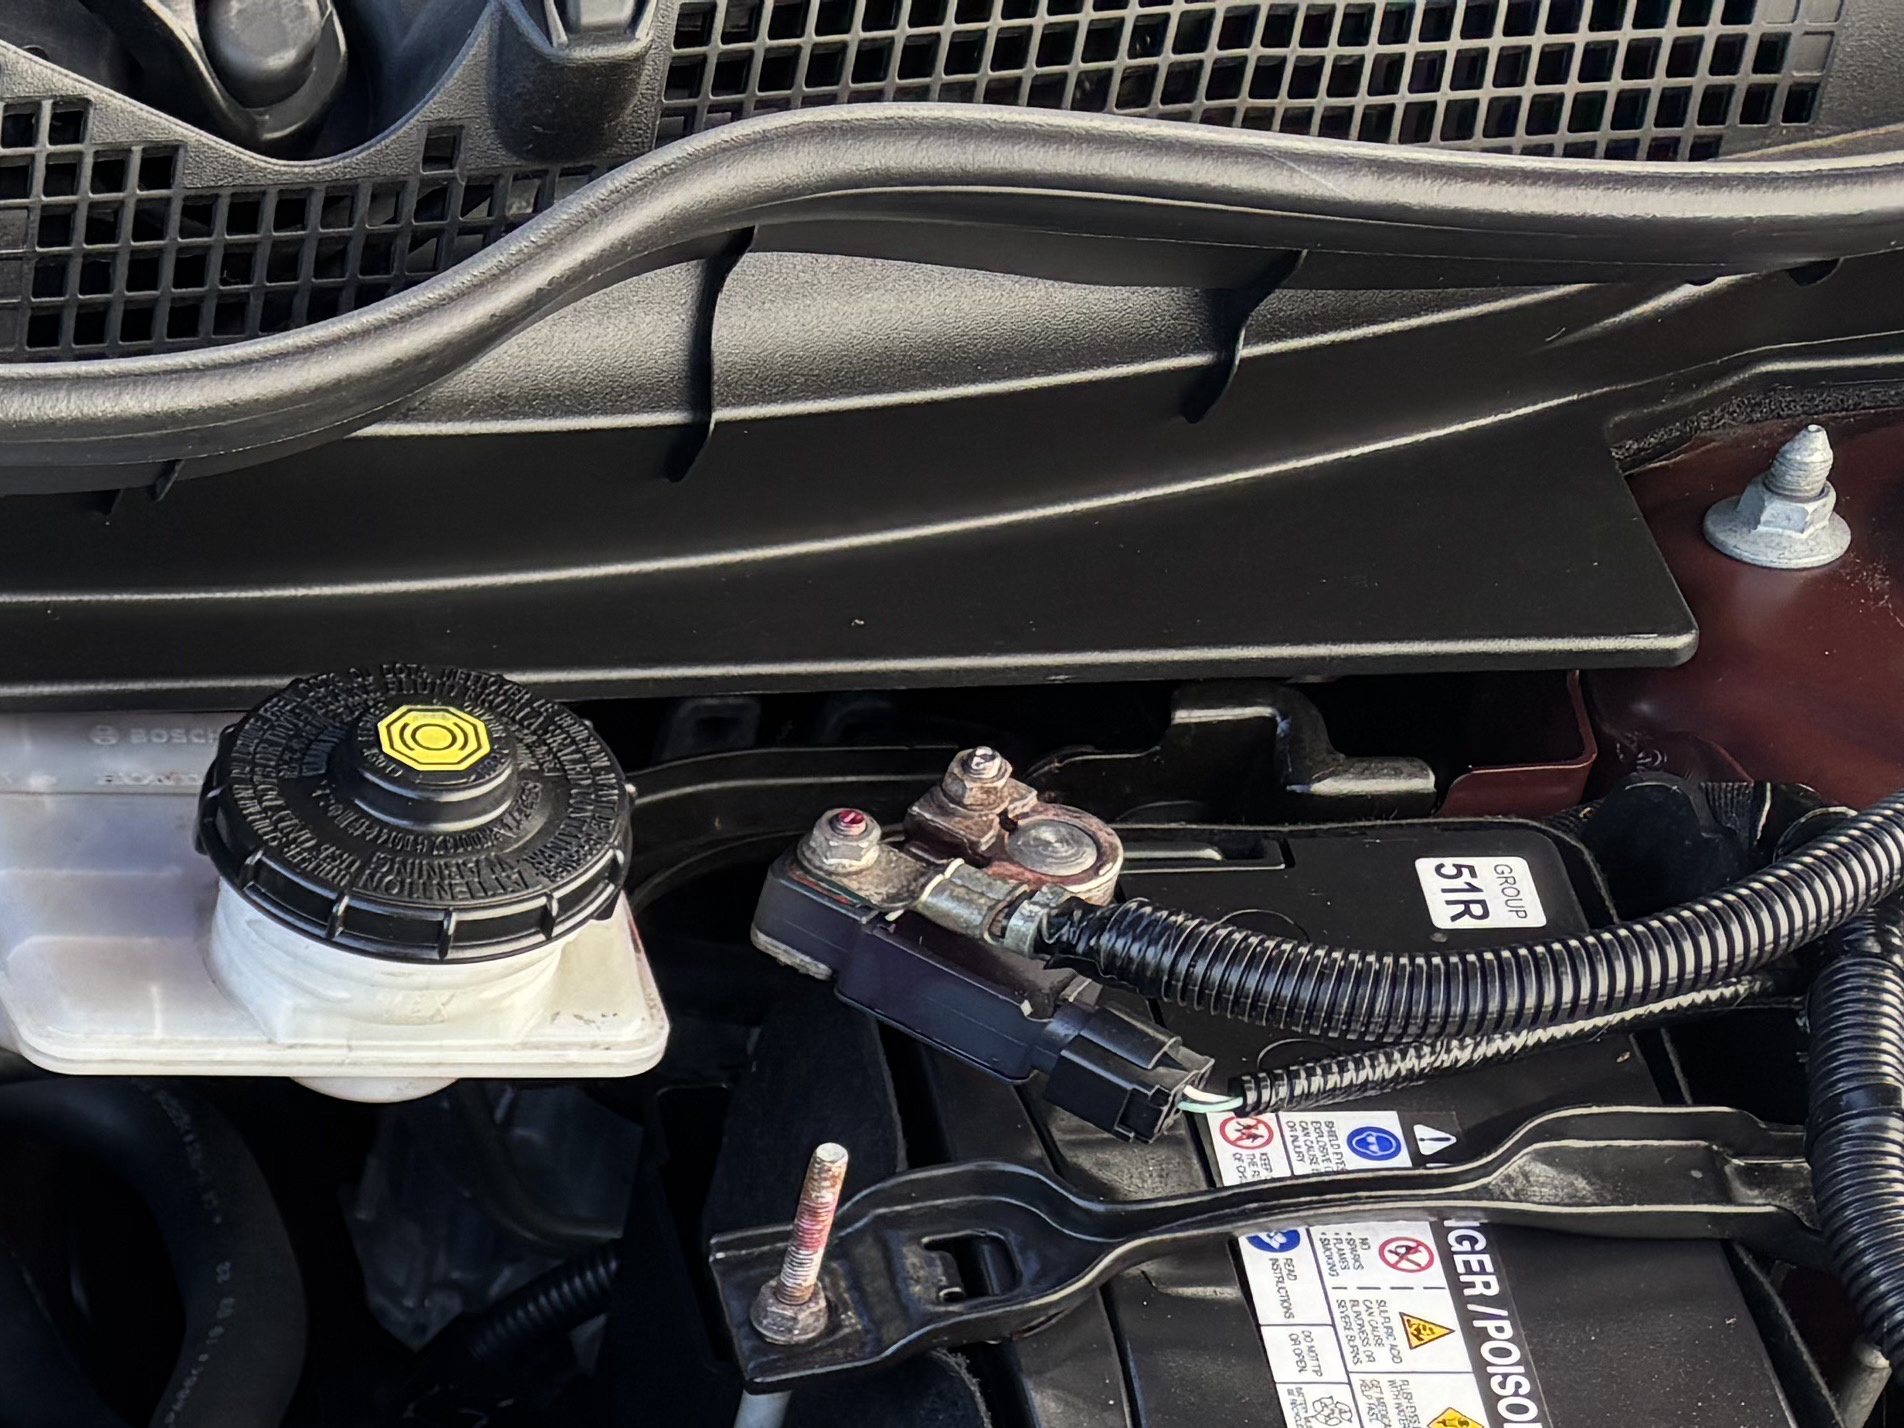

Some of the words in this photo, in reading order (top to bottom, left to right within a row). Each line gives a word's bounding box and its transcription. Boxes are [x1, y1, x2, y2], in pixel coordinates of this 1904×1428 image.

[253, 742, 282, 765] OR
[266, 809, 320, 849] ONLY
[308, 842, 363, 872] USE
[364, 850, 515, 880] WARNING
[353, 867, 535, 899] ATTENTION
[1434, 862, 1490, 922] 51R
[1494, 864, 1527, 919] GROUP
[1299, 1121, 1310, 1137] CAN
[1324, 1120, 1341, 1149] SHIELD
[1304, 1140, 1319, 1165] CAUSE
[1320, 1238, 1339, 1277] SMOKING
[1332, 1238, 1350, 1270] FLAMES
[1345, 1238, 1364, 1270] SPARKS
[1359, 1238, 1371, 1250] NO
[1284, 1258, 1297, 1281] READ
[1268, 1258, 1294, 1320] INSTRUCTIONS
[1336, 1300, 1354, 1331] SEVERE
[1363, 1300, 1375, 1317] CAN
[1369, 1320, 1385, 1347] CAUSE
[1289, 1334, 1301, 1346] OR
[1302, 1330, 1312, 1342] DO
[1349, 1300, 1372, 1347] BLINDNESS
[1363, 1350, 1376, 1362] OR
[1375, 1299, 1396, 1340] SULFURIC
[1389, 1344, 1402, 1364] ACID
[1359, 1379, 1372, 1400] HELP
[1370, 1380, 1383, 1394] GET
[1388, 1380, 1402, 1400] WITH
